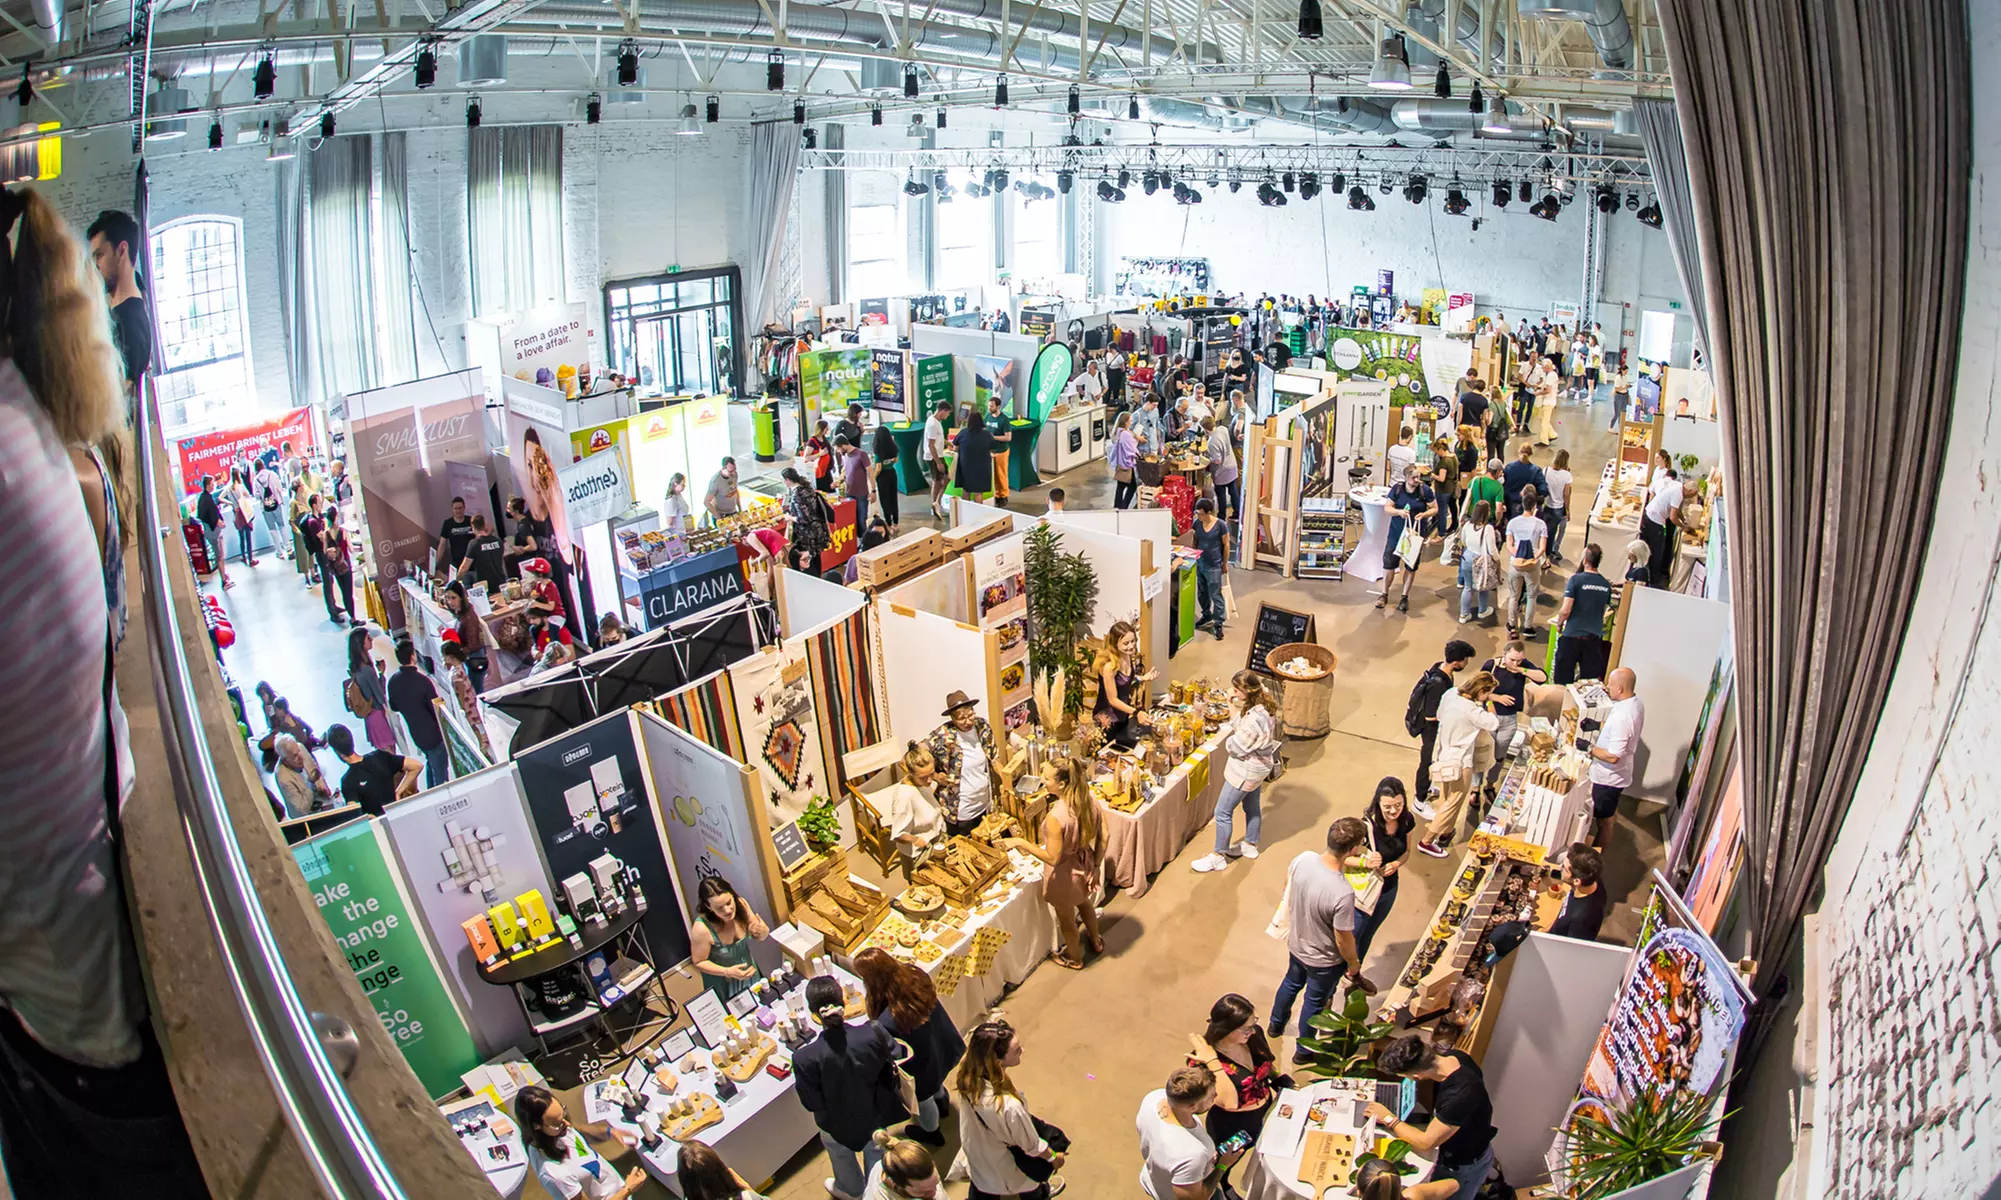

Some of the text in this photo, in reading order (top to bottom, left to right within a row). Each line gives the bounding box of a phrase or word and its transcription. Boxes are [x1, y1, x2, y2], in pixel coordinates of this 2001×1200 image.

[514, 321, 580, 349] From a date to
[517, 335, 571, 360] a love affair.
[876, 353, 900, 364] natur
[825, 368, 866, 380] natur
[188, 442, 235, 462] FAIRMENT
[272, 424, 303, 439] LEBEN
[219, 457, 230, 467] IN
[649, 573, 739, 619] CLARANA
[313, 882, 350, 907] ake
[343, 897, 380, 921] the
[1641, 1006, 1661, 1034] eine
[1653, 1003, 1677, 1037] Alltag
[579, 1059, 599, 1073] So
[579, 1066, 606, 1083] free
